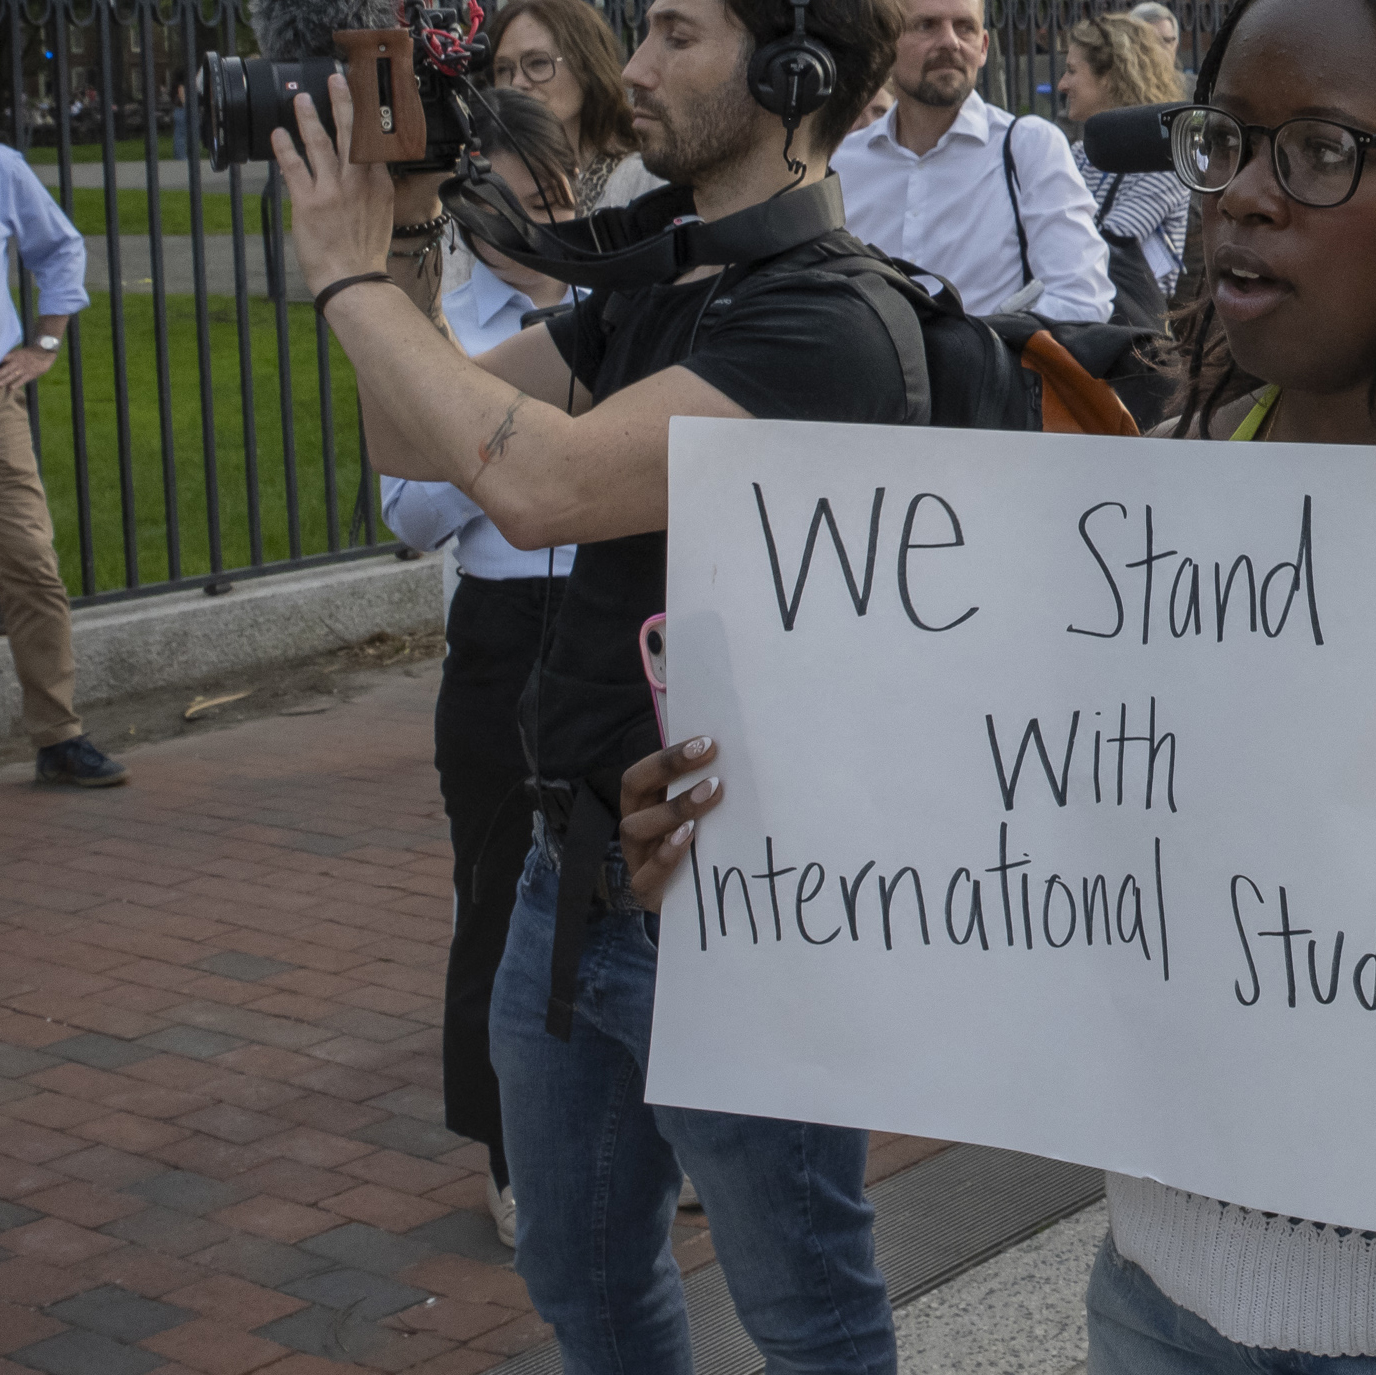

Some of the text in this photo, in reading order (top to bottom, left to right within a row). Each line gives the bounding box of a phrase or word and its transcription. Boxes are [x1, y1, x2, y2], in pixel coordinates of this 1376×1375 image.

[751, 481, 1325, 646] We Stand
[689, 821, 1170, 982] International
